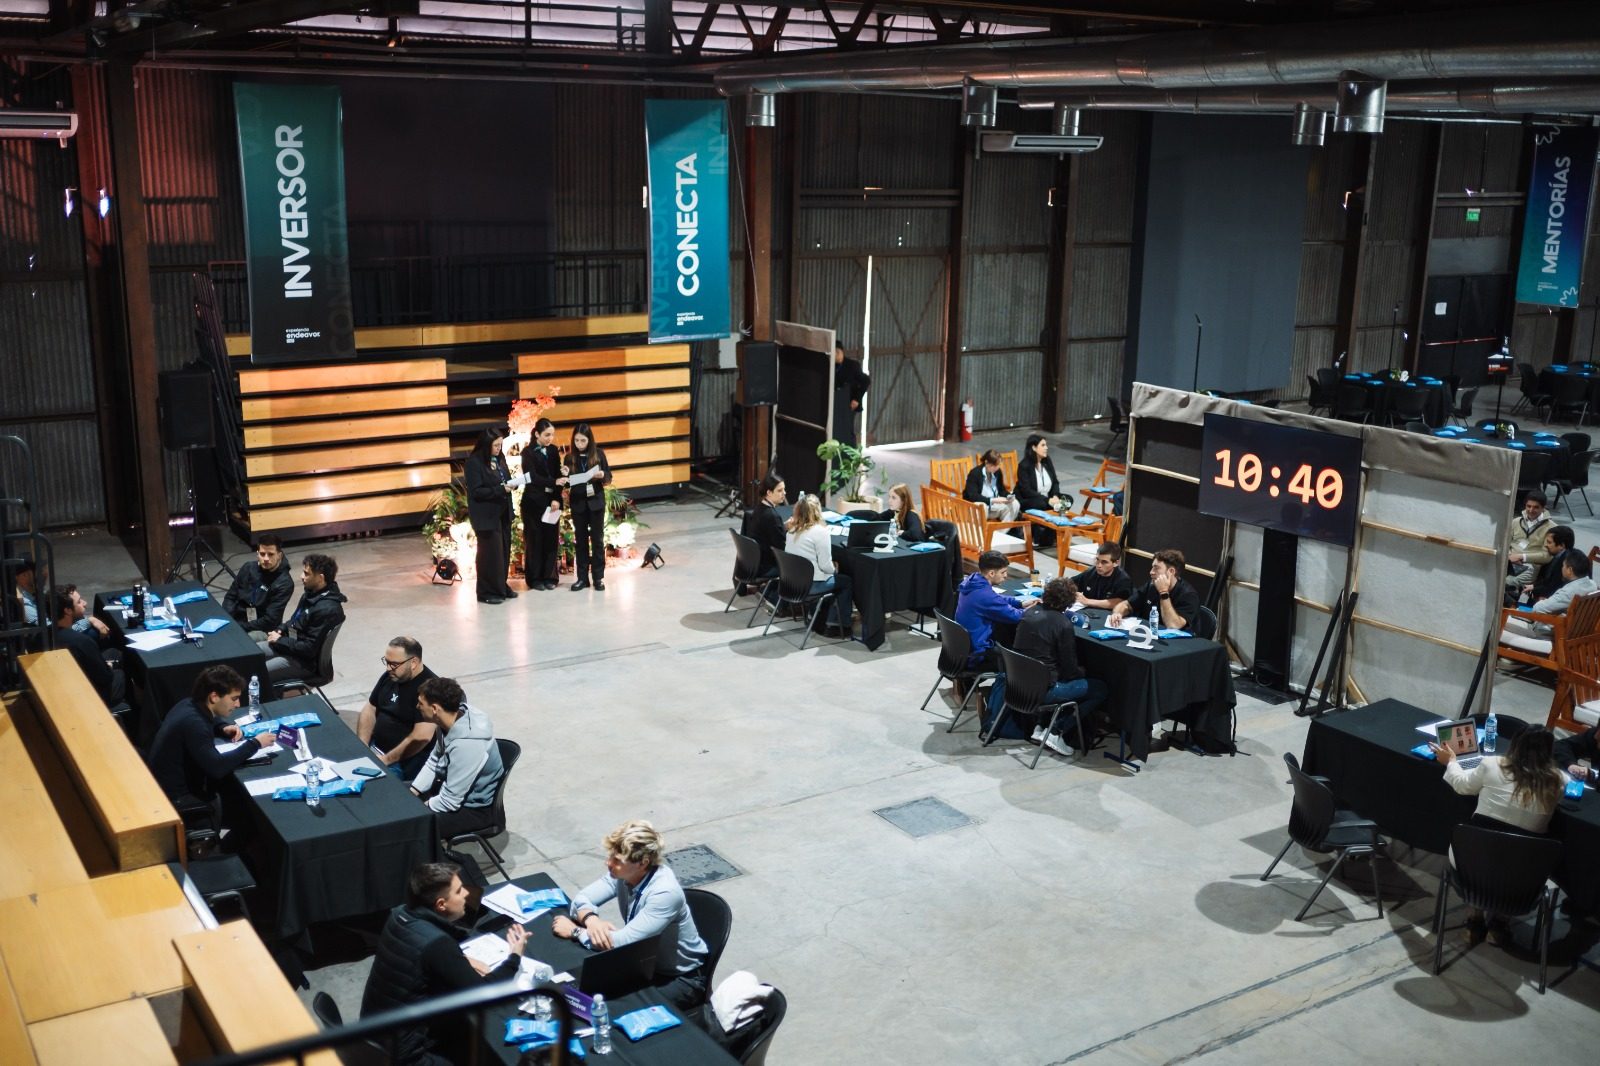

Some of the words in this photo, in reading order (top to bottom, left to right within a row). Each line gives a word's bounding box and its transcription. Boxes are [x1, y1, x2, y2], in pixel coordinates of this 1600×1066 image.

[275, 124, 312, 298] INVERSOR
[675, 152, 700, 297] CONECTA
[1541, 156, 1571, 274] MENTORÍAS
[1214, 449, 1343, 509] 10:40
